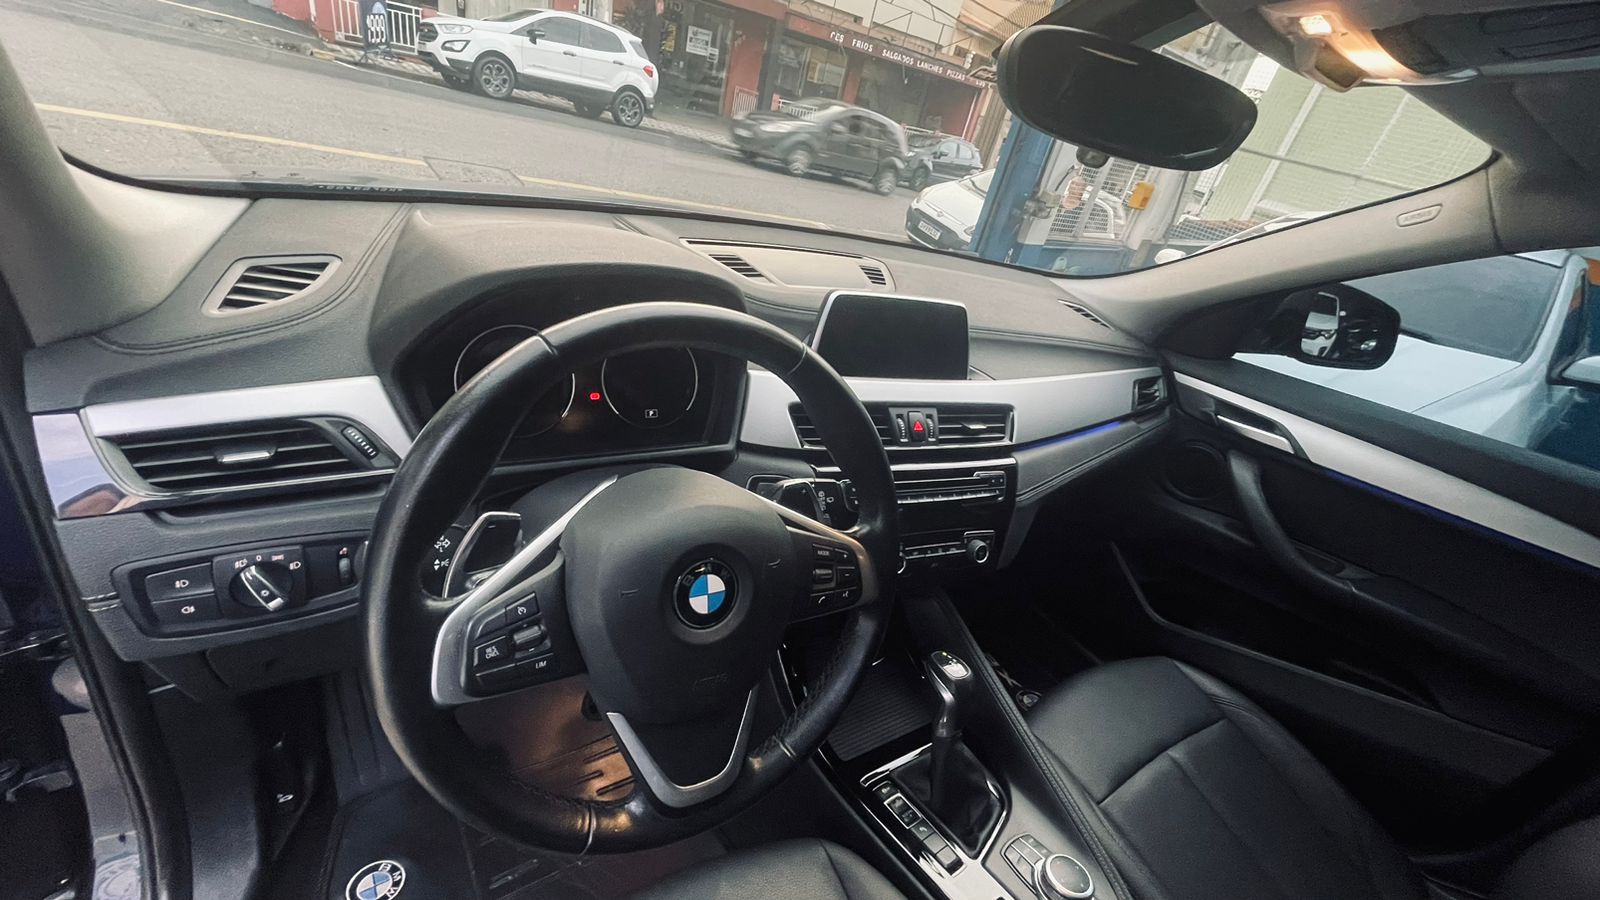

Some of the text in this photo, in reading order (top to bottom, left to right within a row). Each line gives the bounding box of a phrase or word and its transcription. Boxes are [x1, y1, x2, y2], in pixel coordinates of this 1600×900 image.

[852, 39, 873, 53] FRIOS
[917, 60, 943, 74] LANCHES
[946, 69, 966, 81] PIZZAS
[379, 863, 401, 898] BMW
